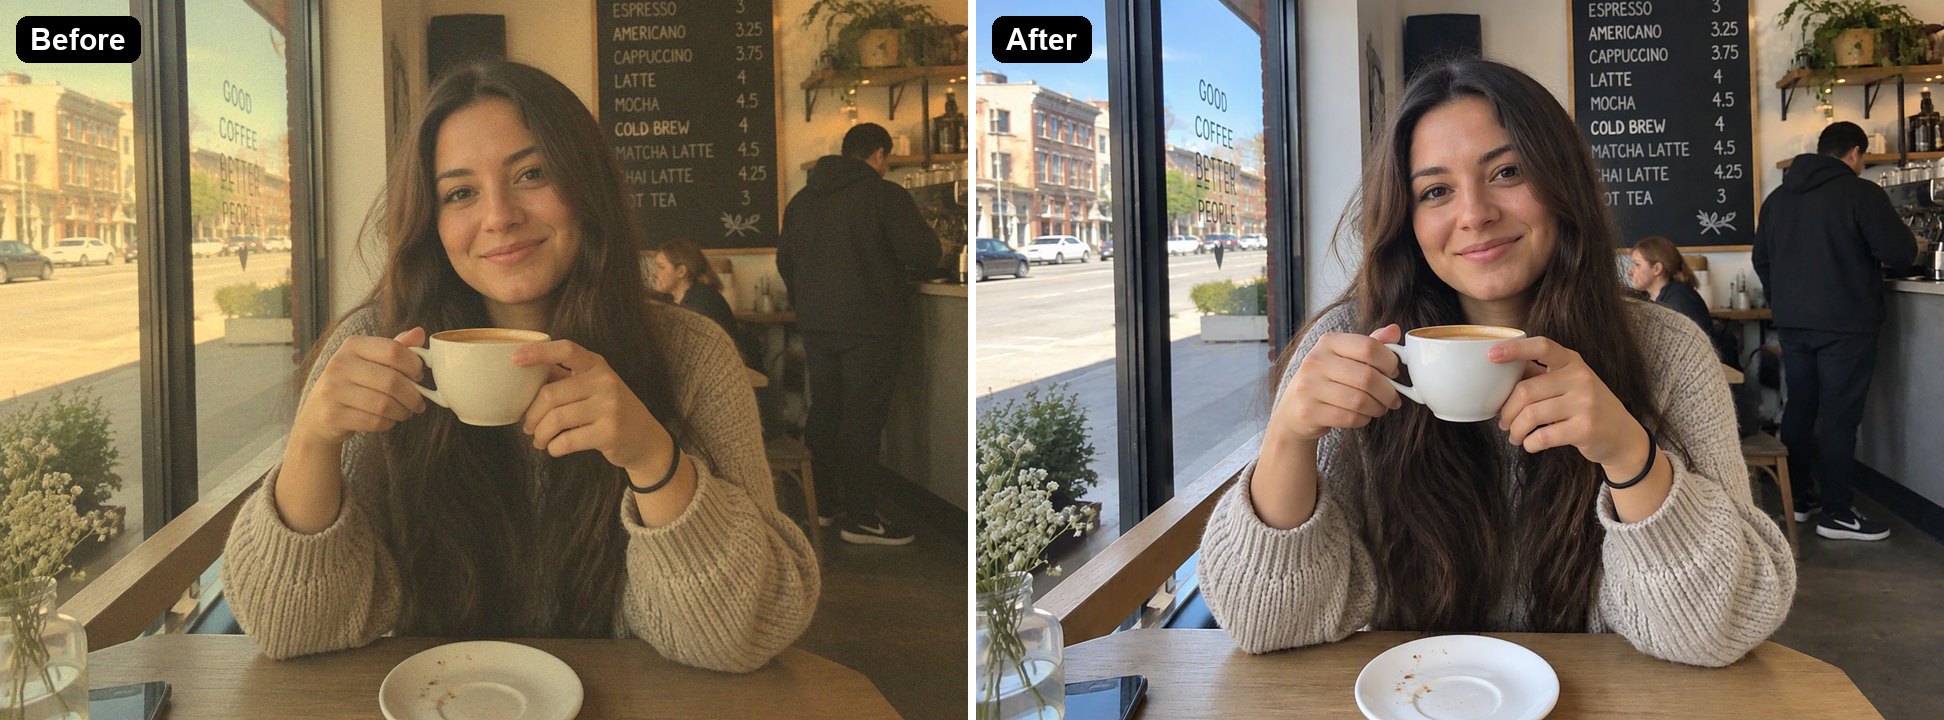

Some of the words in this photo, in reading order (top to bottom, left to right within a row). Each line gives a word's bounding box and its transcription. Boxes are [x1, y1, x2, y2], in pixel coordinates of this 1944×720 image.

[613, 2, 676, 17] ESPRESSO
[736, 0, 745, 14] 3
[1588, 2, 1652, 17] ESPRESSO
[1711, 0, 1721, 13] 3
[613, 25, 686, 41] AMERICANO
[736, 22, 763, 37] 3.25
[1588, 24, 1662, 41] AMERICANO
[1711, 21, 1739, 37] 3.25
[614, 48, 693, 64] CAPPUCCINO
[736, 46, 763, 61] 3.75
[1589, 48, 1668, 64] CAPPUCCINO
[1711, 45, 1739, 61] 3.75
[614, 73, 656, 88] LATTE
[737, 70, 746, 85] 4
[1590, 72, 1632, 88] LATTE
[1713, 69, 1723, 84] 4
[223, 79, 252, 115] GOOD
[615, 97, 660, 112] MOCHA
[736, 93, 759, 109] 4.5
[1199, 78, 1228, 113] GOOD
[1590, 96, 1636, 111] MOCHA
[1712, 92, 1735, 108] 4.5
[219, 116, 258, 151] COFFEE
[615, 121, 648, 136] COLD
[653, 121, 690, 136] BREW
[739, 117, 748, 133] 4
[1195, 115, 1234, 150] COFFEE
[1590, 120, 1625, 135] COLD
[1629, 119, 1666, 134] BREW
[1715, 116, 1725, 132] 4
[615, 145, 668, 160] MATCHA
[673, 143, 714, 159] LATTE
[738, 142, 760, 157] 4.5
[1591, 143, 1644, 159] MATCHA
[1648, 142, 1690, 157] LATTE
[1713, 140, 1735, 156] 4.5
[220, 152, 261, 198] BETTER
[624, 169, 646, 184] HAI
[651, 168, 694, 184] LATTE
[738, 166, 767, 181] 4.25
[1195, 152, 1237, 196] BETTER
[1627, 166, 1670, 182] LATTE
[1713, 164, 1743, 180] 4.25
[650, 193, 677, 208] TEA
[742, 190, 750, 205] 3
[1626, 190, 1653, 206] TEA
[1717, 188, 1726, 204] 3
[222, 201, 262, 228] PEOPLE
[1198, 200, 1237, 225] PEOPLE
